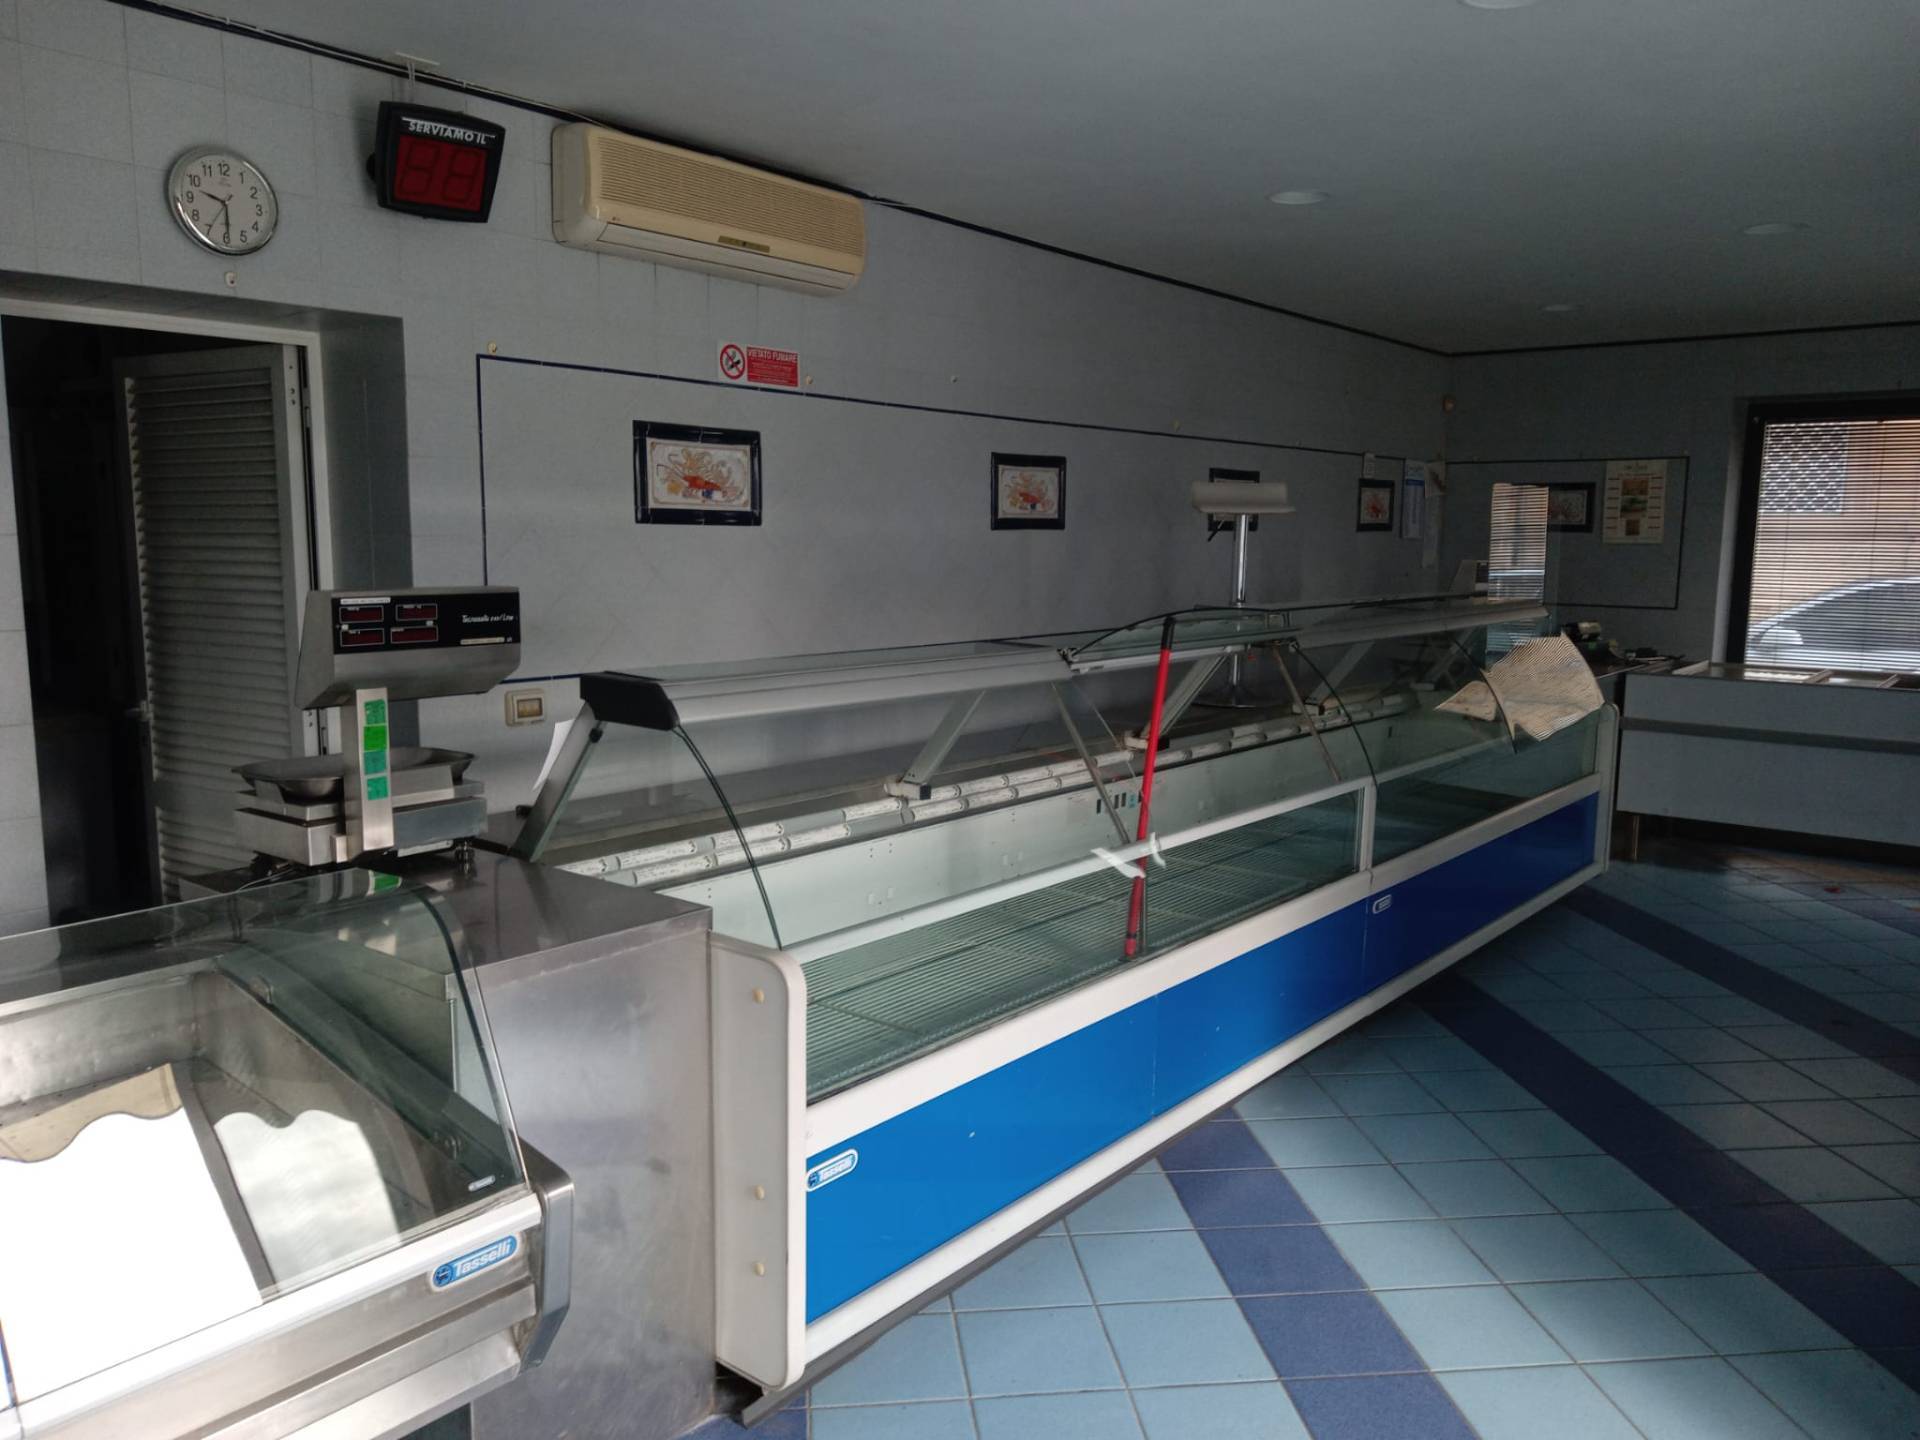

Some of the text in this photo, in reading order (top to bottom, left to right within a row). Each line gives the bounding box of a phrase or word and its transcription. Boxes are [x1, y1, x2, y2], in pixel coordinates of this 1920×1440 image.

[409, 121, 487, 145] SERVIAMO IL
[203, 164, 212, 177] 11
[218, 163, 230, 177] 12
[187, 174, 201, 188] 10
[239, 172, 244, 185] 1
[186, 191, 194, 204] 9
[250, 187, 258, 200] 2
[192, 209, 200, 222] 8
[256, 204, 263, 217] 3
[205, 223, 213, 237] 7
[252, 221, 259, 233] 4
[223, 232, 231, 244] 6
[239, 230, 247, 243] 5
[748, 350, 797, 363] VIETATO FUMARE
[454, 1240, 511, 1276] Tasselli
